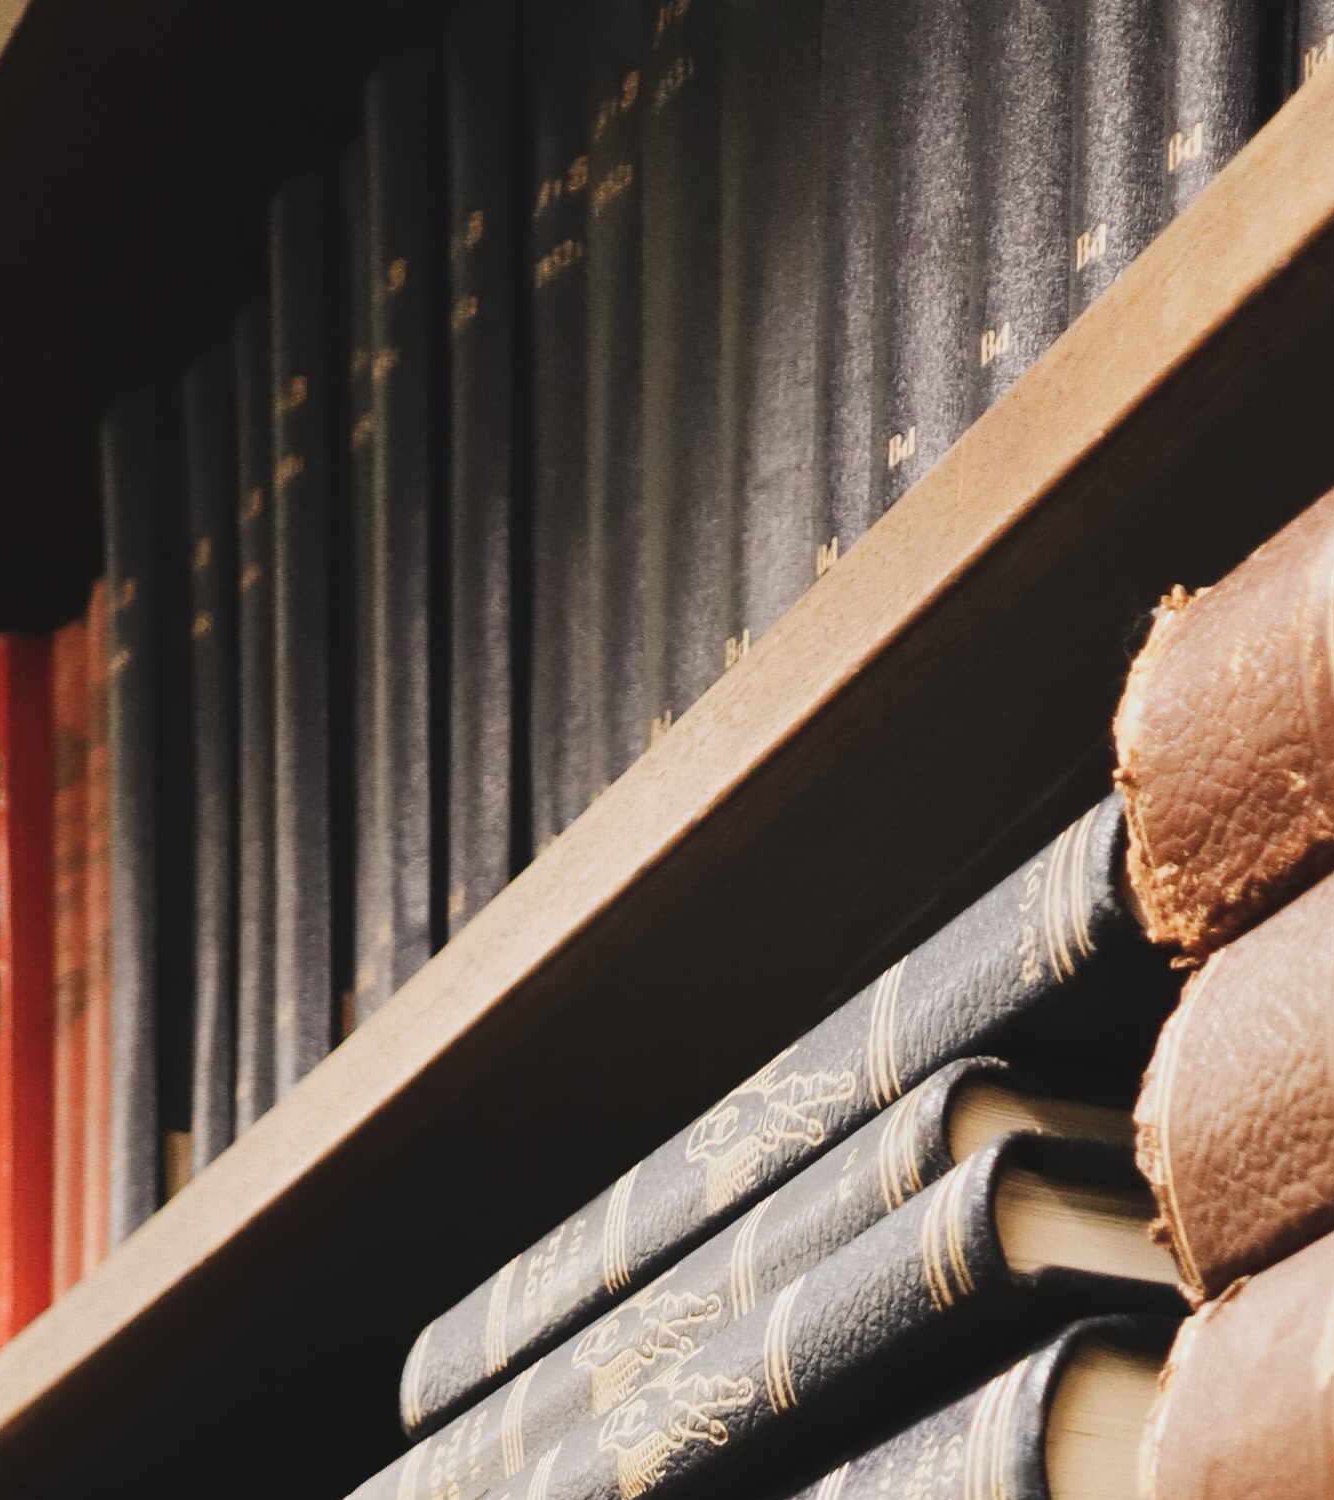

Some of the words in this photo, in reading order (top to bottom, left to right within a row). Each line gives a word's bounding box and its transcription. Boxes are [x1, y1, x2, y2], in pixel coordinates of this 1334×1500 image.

[1168, 123, 1202, 172] Bd
[1076, 224, 1107, 271] Bd
[980, 322, 1010, 368] Bd
[888, 426, 916, 468] Bd
[816, 537, 838, 575] Bd
[725, 630, 750, 668] Bd
